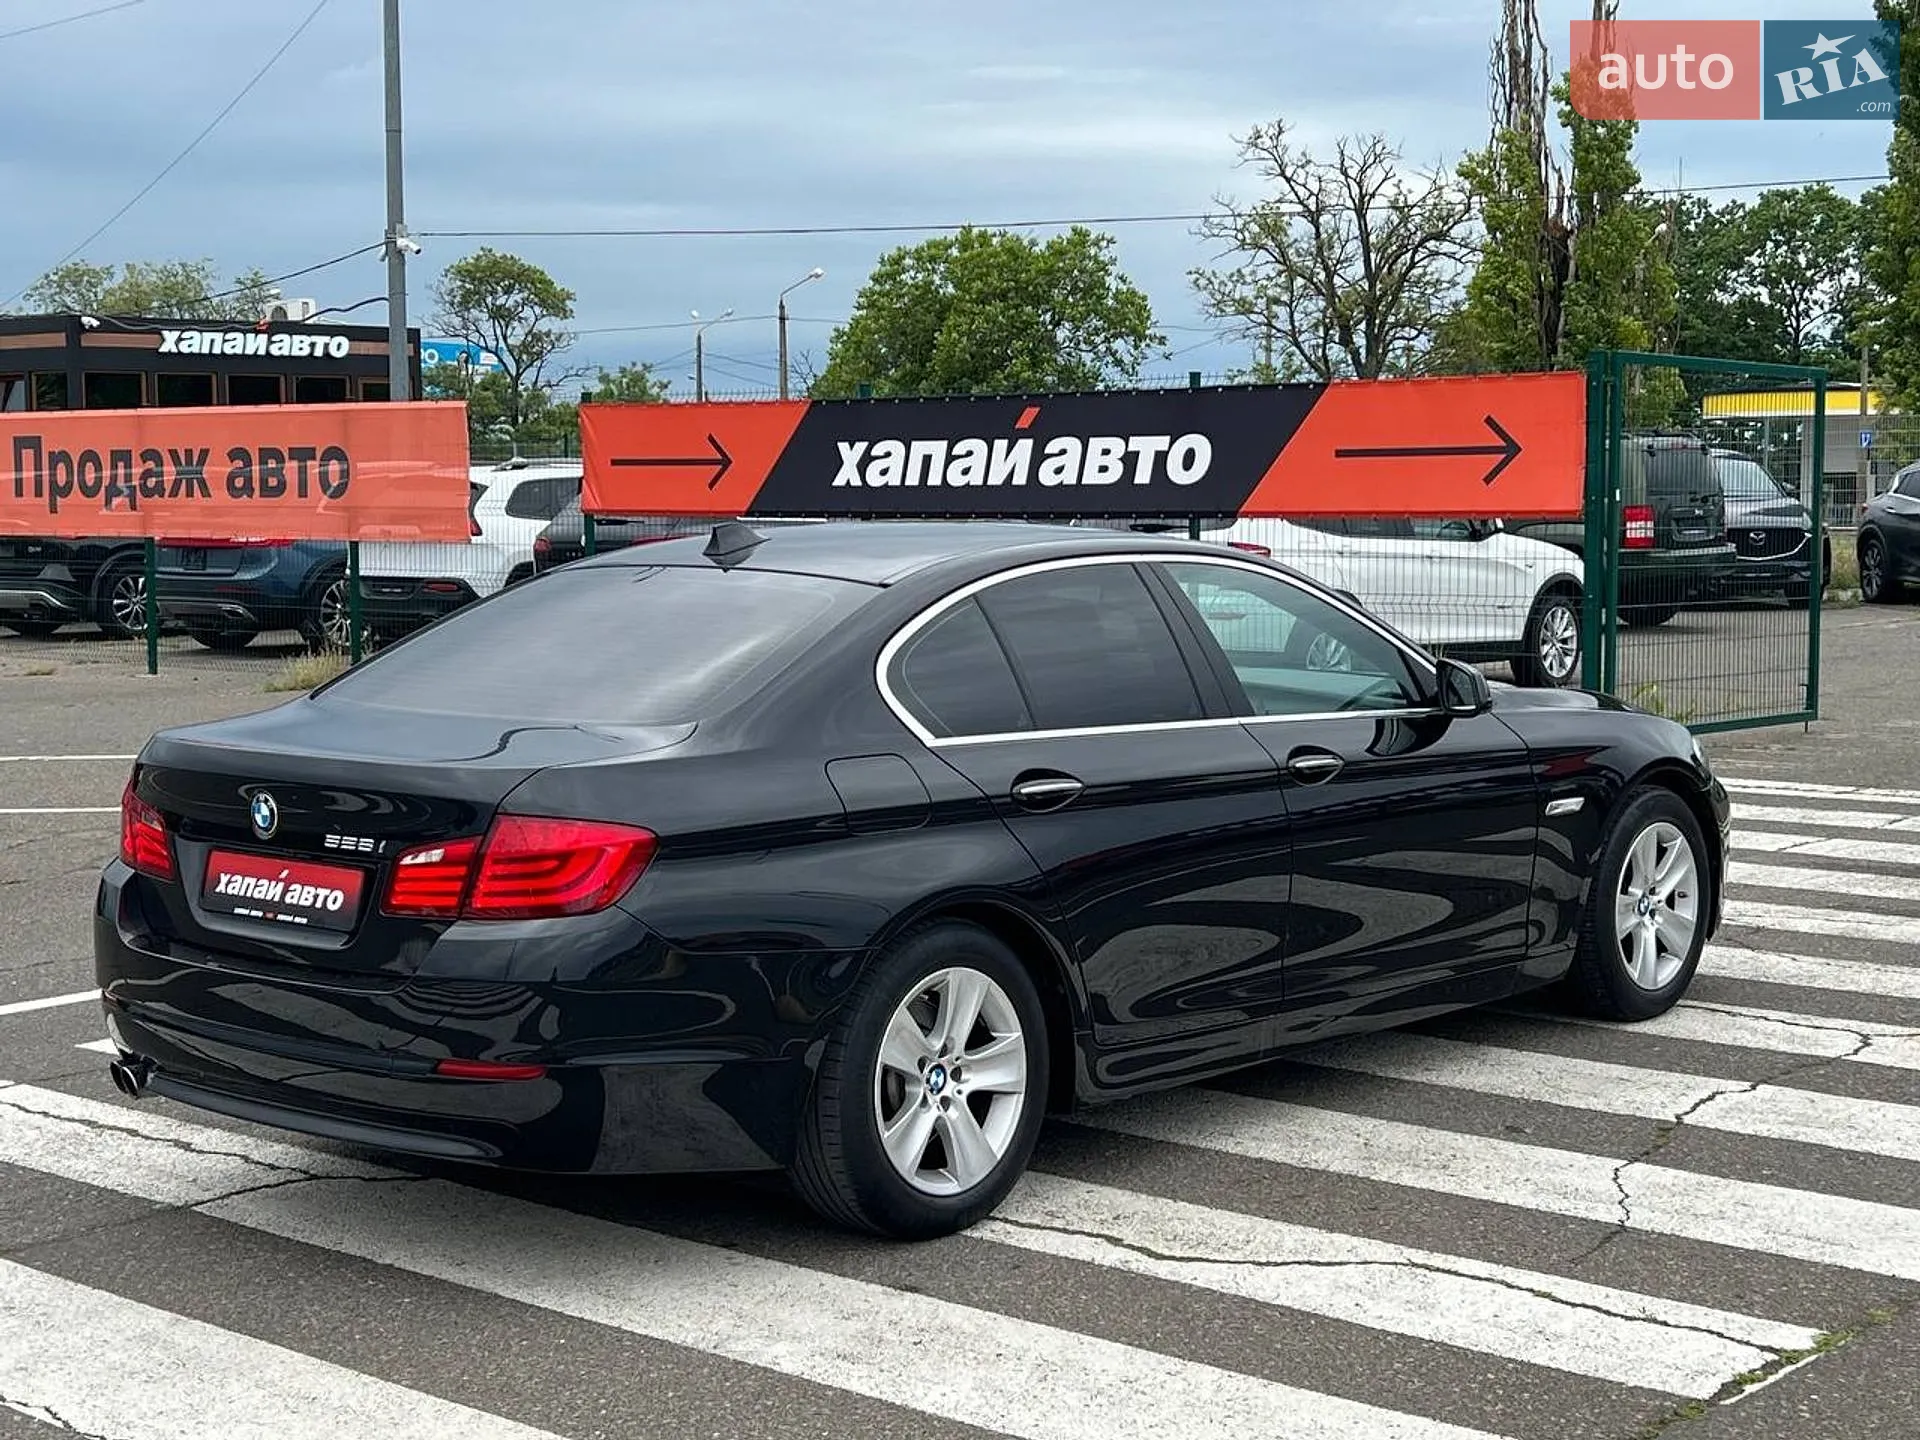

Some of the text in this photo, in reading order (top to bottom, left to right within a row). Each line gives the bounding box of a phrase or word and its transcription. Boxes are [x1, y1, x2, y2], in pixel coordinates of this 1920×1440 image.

[269, 333, 350, 358] авто
[12, 434, 350, 515] Продаж авто
[831, 406, 1213, 487] хапай авто
[215, 869, 345, 912] хапай авто
